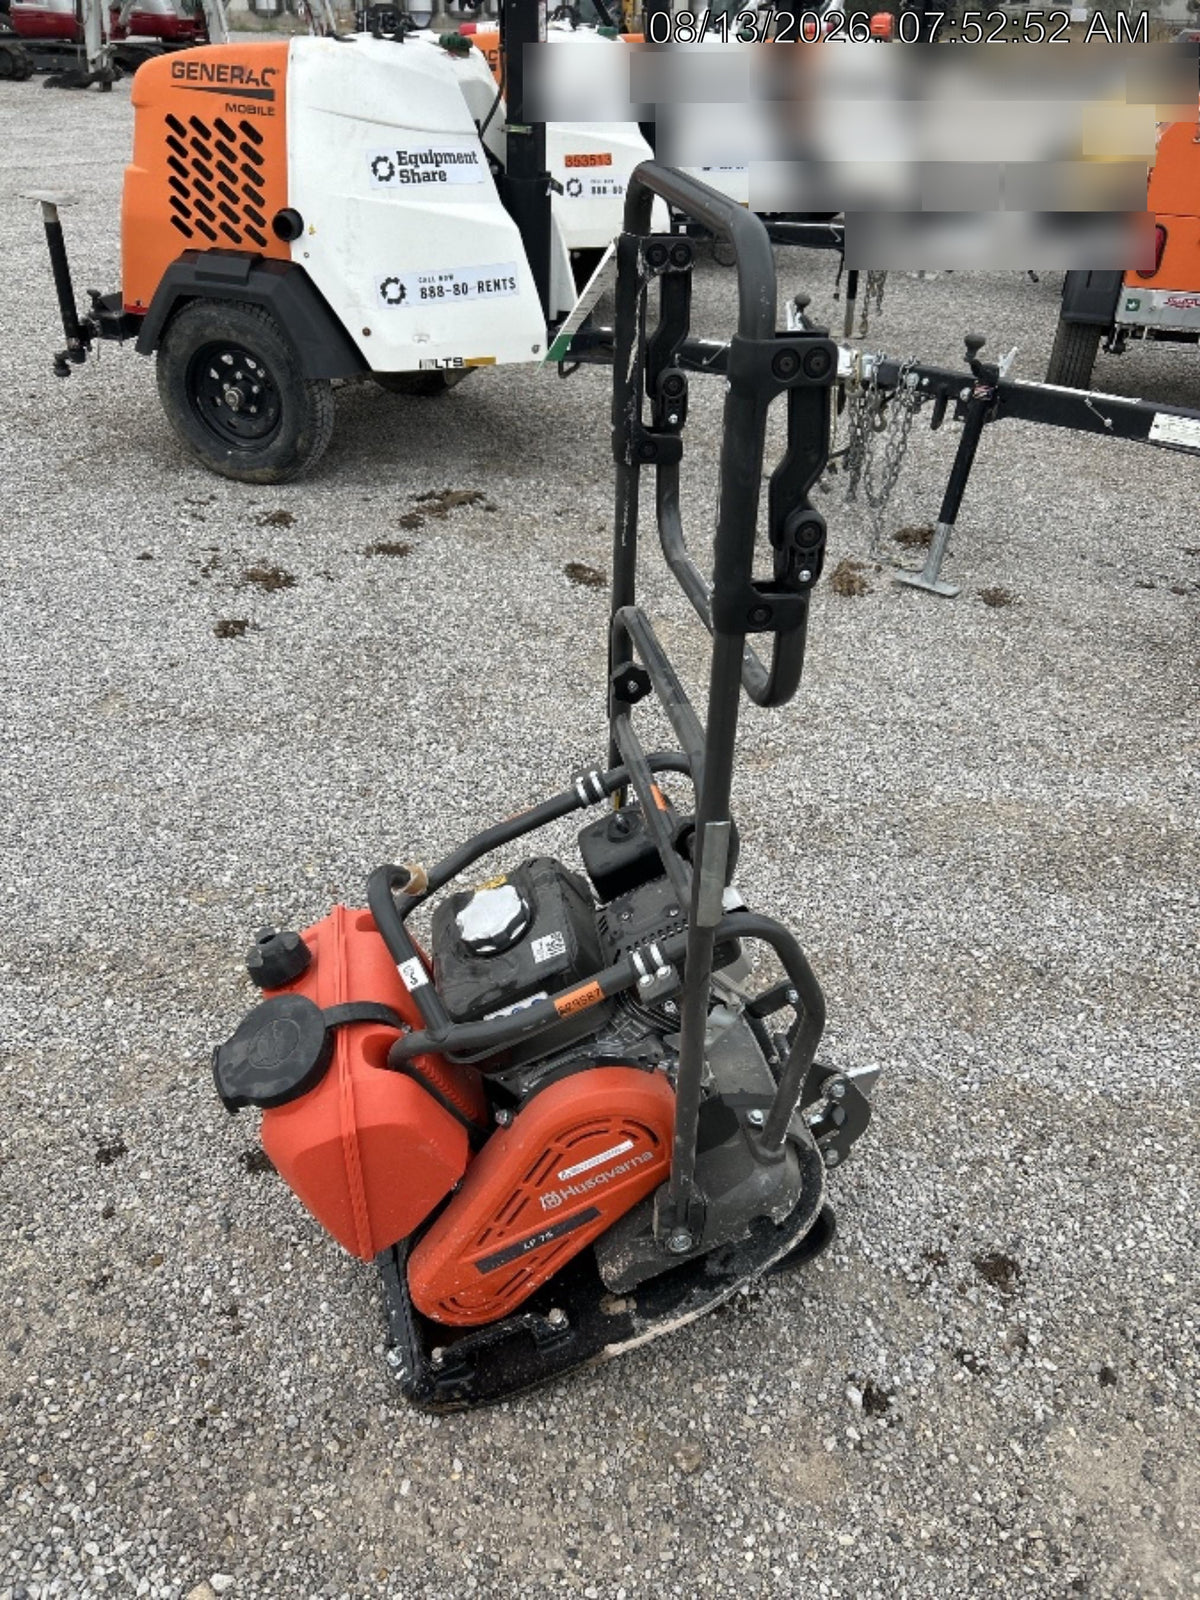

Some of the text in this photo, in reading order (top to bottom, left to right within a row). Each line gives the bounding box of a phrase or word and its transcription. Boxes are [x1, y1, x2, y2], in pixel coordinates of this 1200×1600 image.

[172, 61, 276, 88] GENERAC
[225, 103, 275, 116] MOBILE
[396, 149, 478, 168] Equipment
[399, 169, 447, 184] Share
[560, 1150, 654, 1201] Husqvarna
